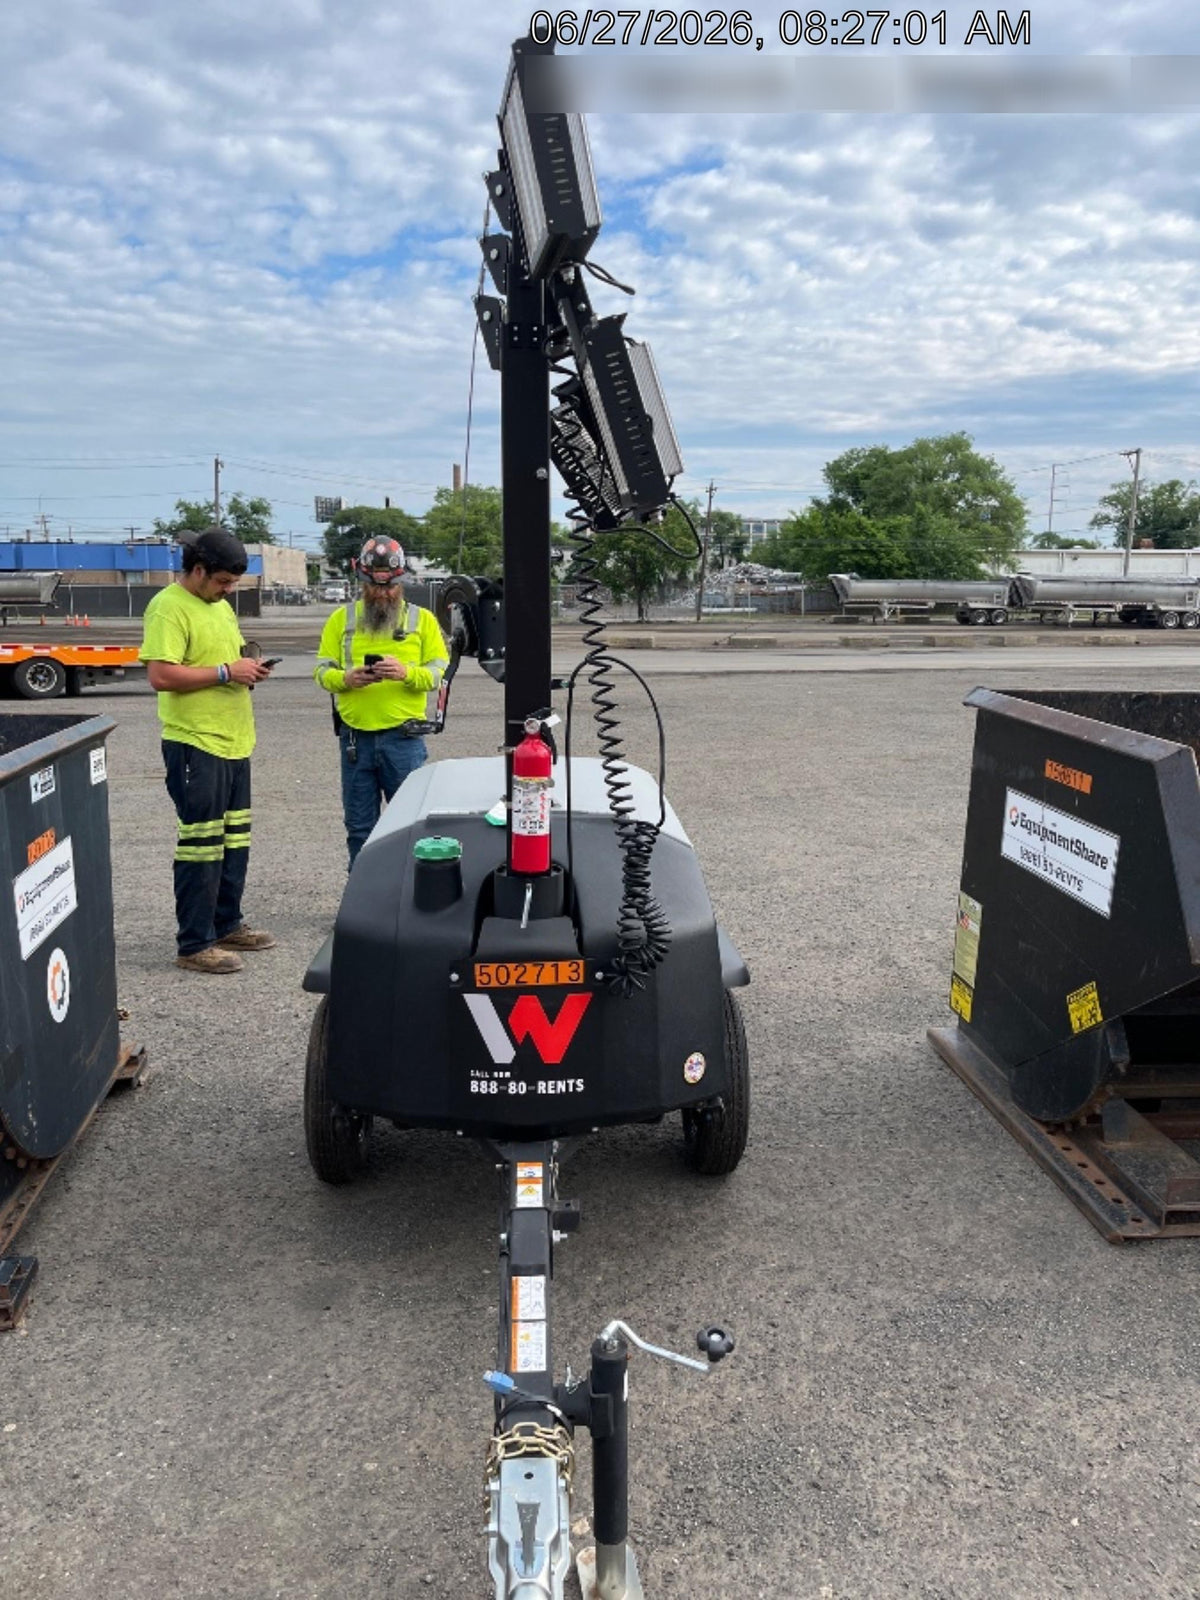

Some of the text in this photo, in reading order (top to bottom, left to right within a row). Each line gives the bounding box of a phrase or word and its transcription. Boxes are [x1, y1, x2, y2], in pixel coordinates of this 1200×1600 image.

[1020, 811, 1110, 870] EquipmentShare
[478, 961, 581, 986] 502713
[470, 1078, 585, 1095] 888-80-RENTS
